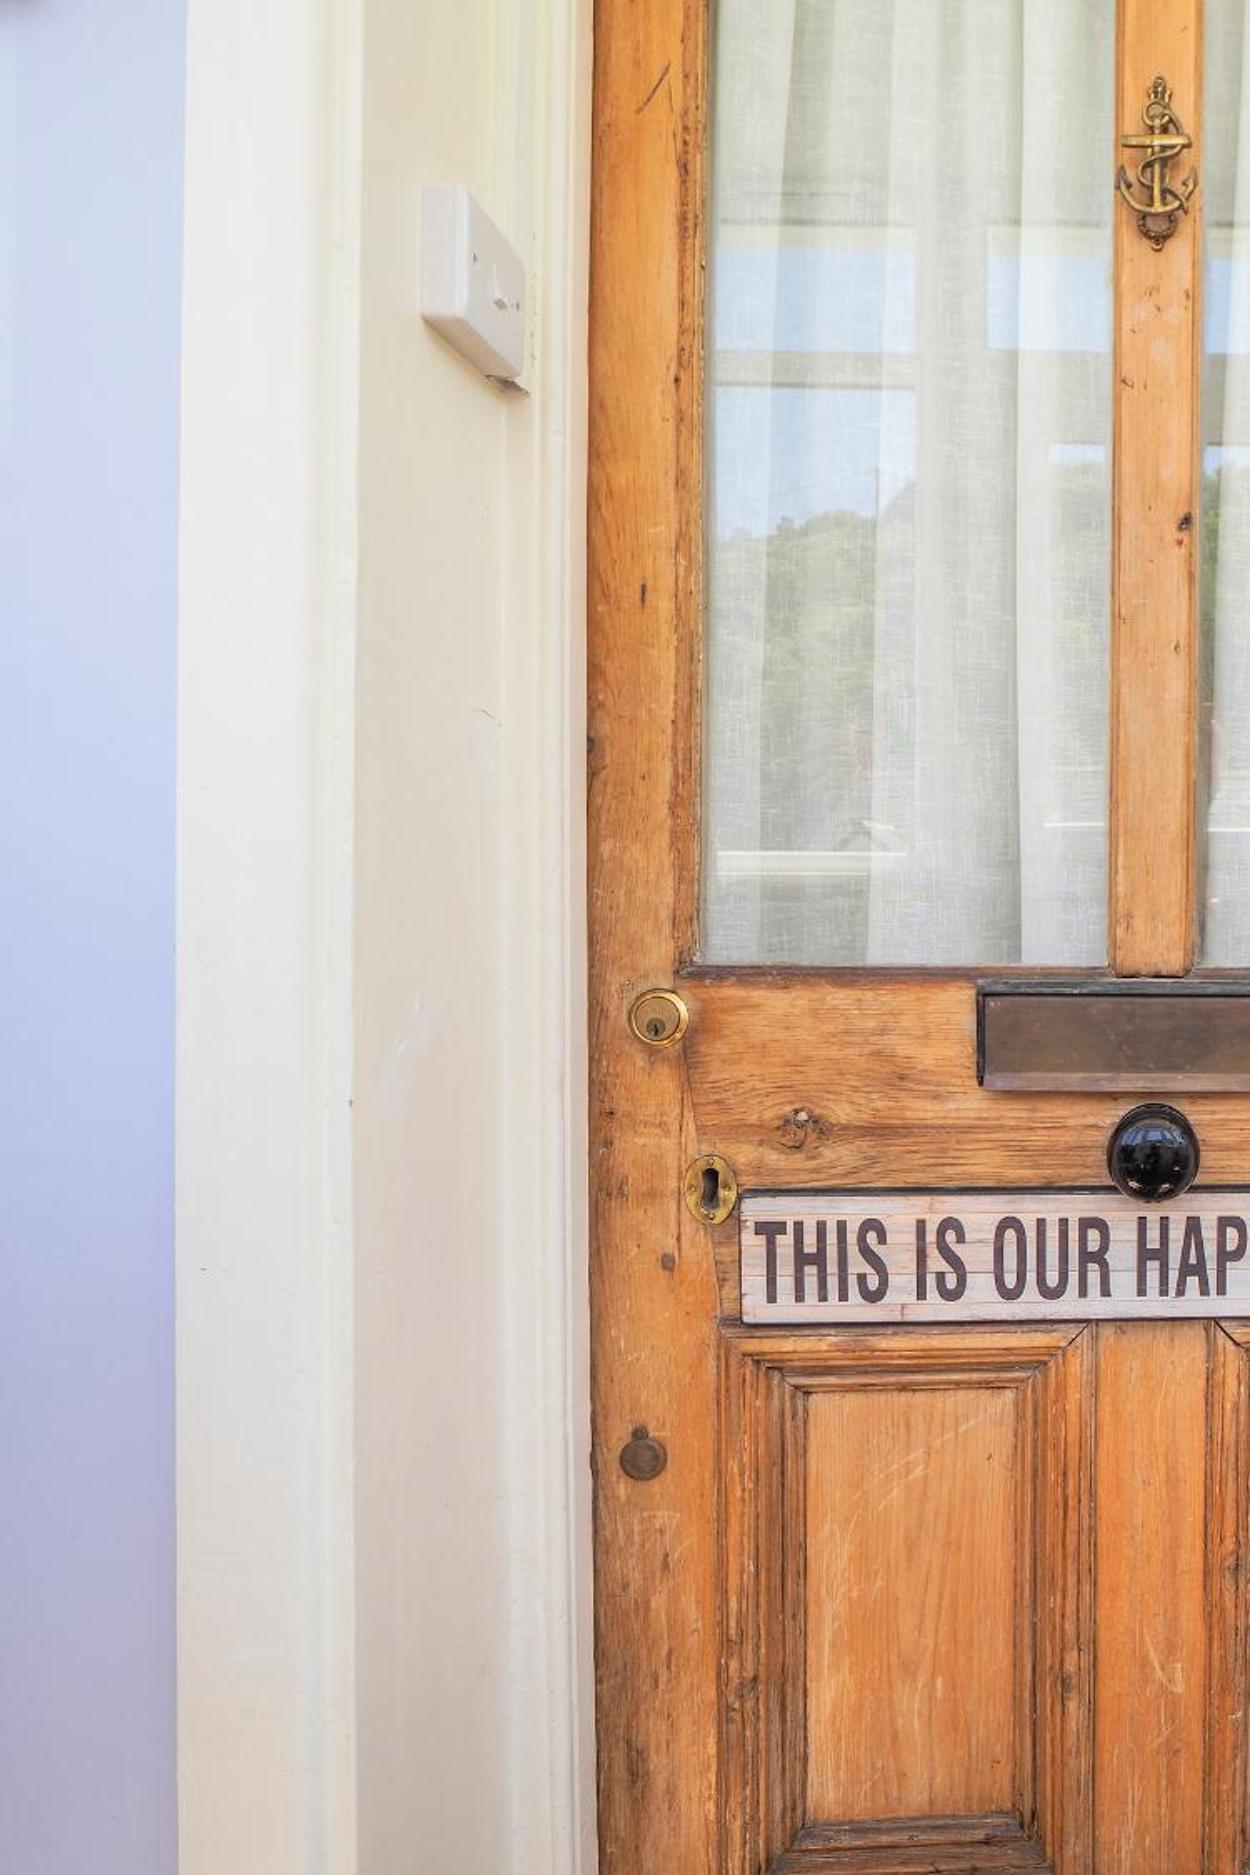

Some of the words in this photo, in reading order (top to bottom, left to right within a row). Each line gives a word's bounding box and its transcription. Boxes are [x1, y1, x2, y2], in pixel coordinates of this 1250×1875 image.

[754, 1218, 889, 1304] THIS
[915, 1216, 968, 1302] IS
[992, 1216, 1112, 1301] OUR
